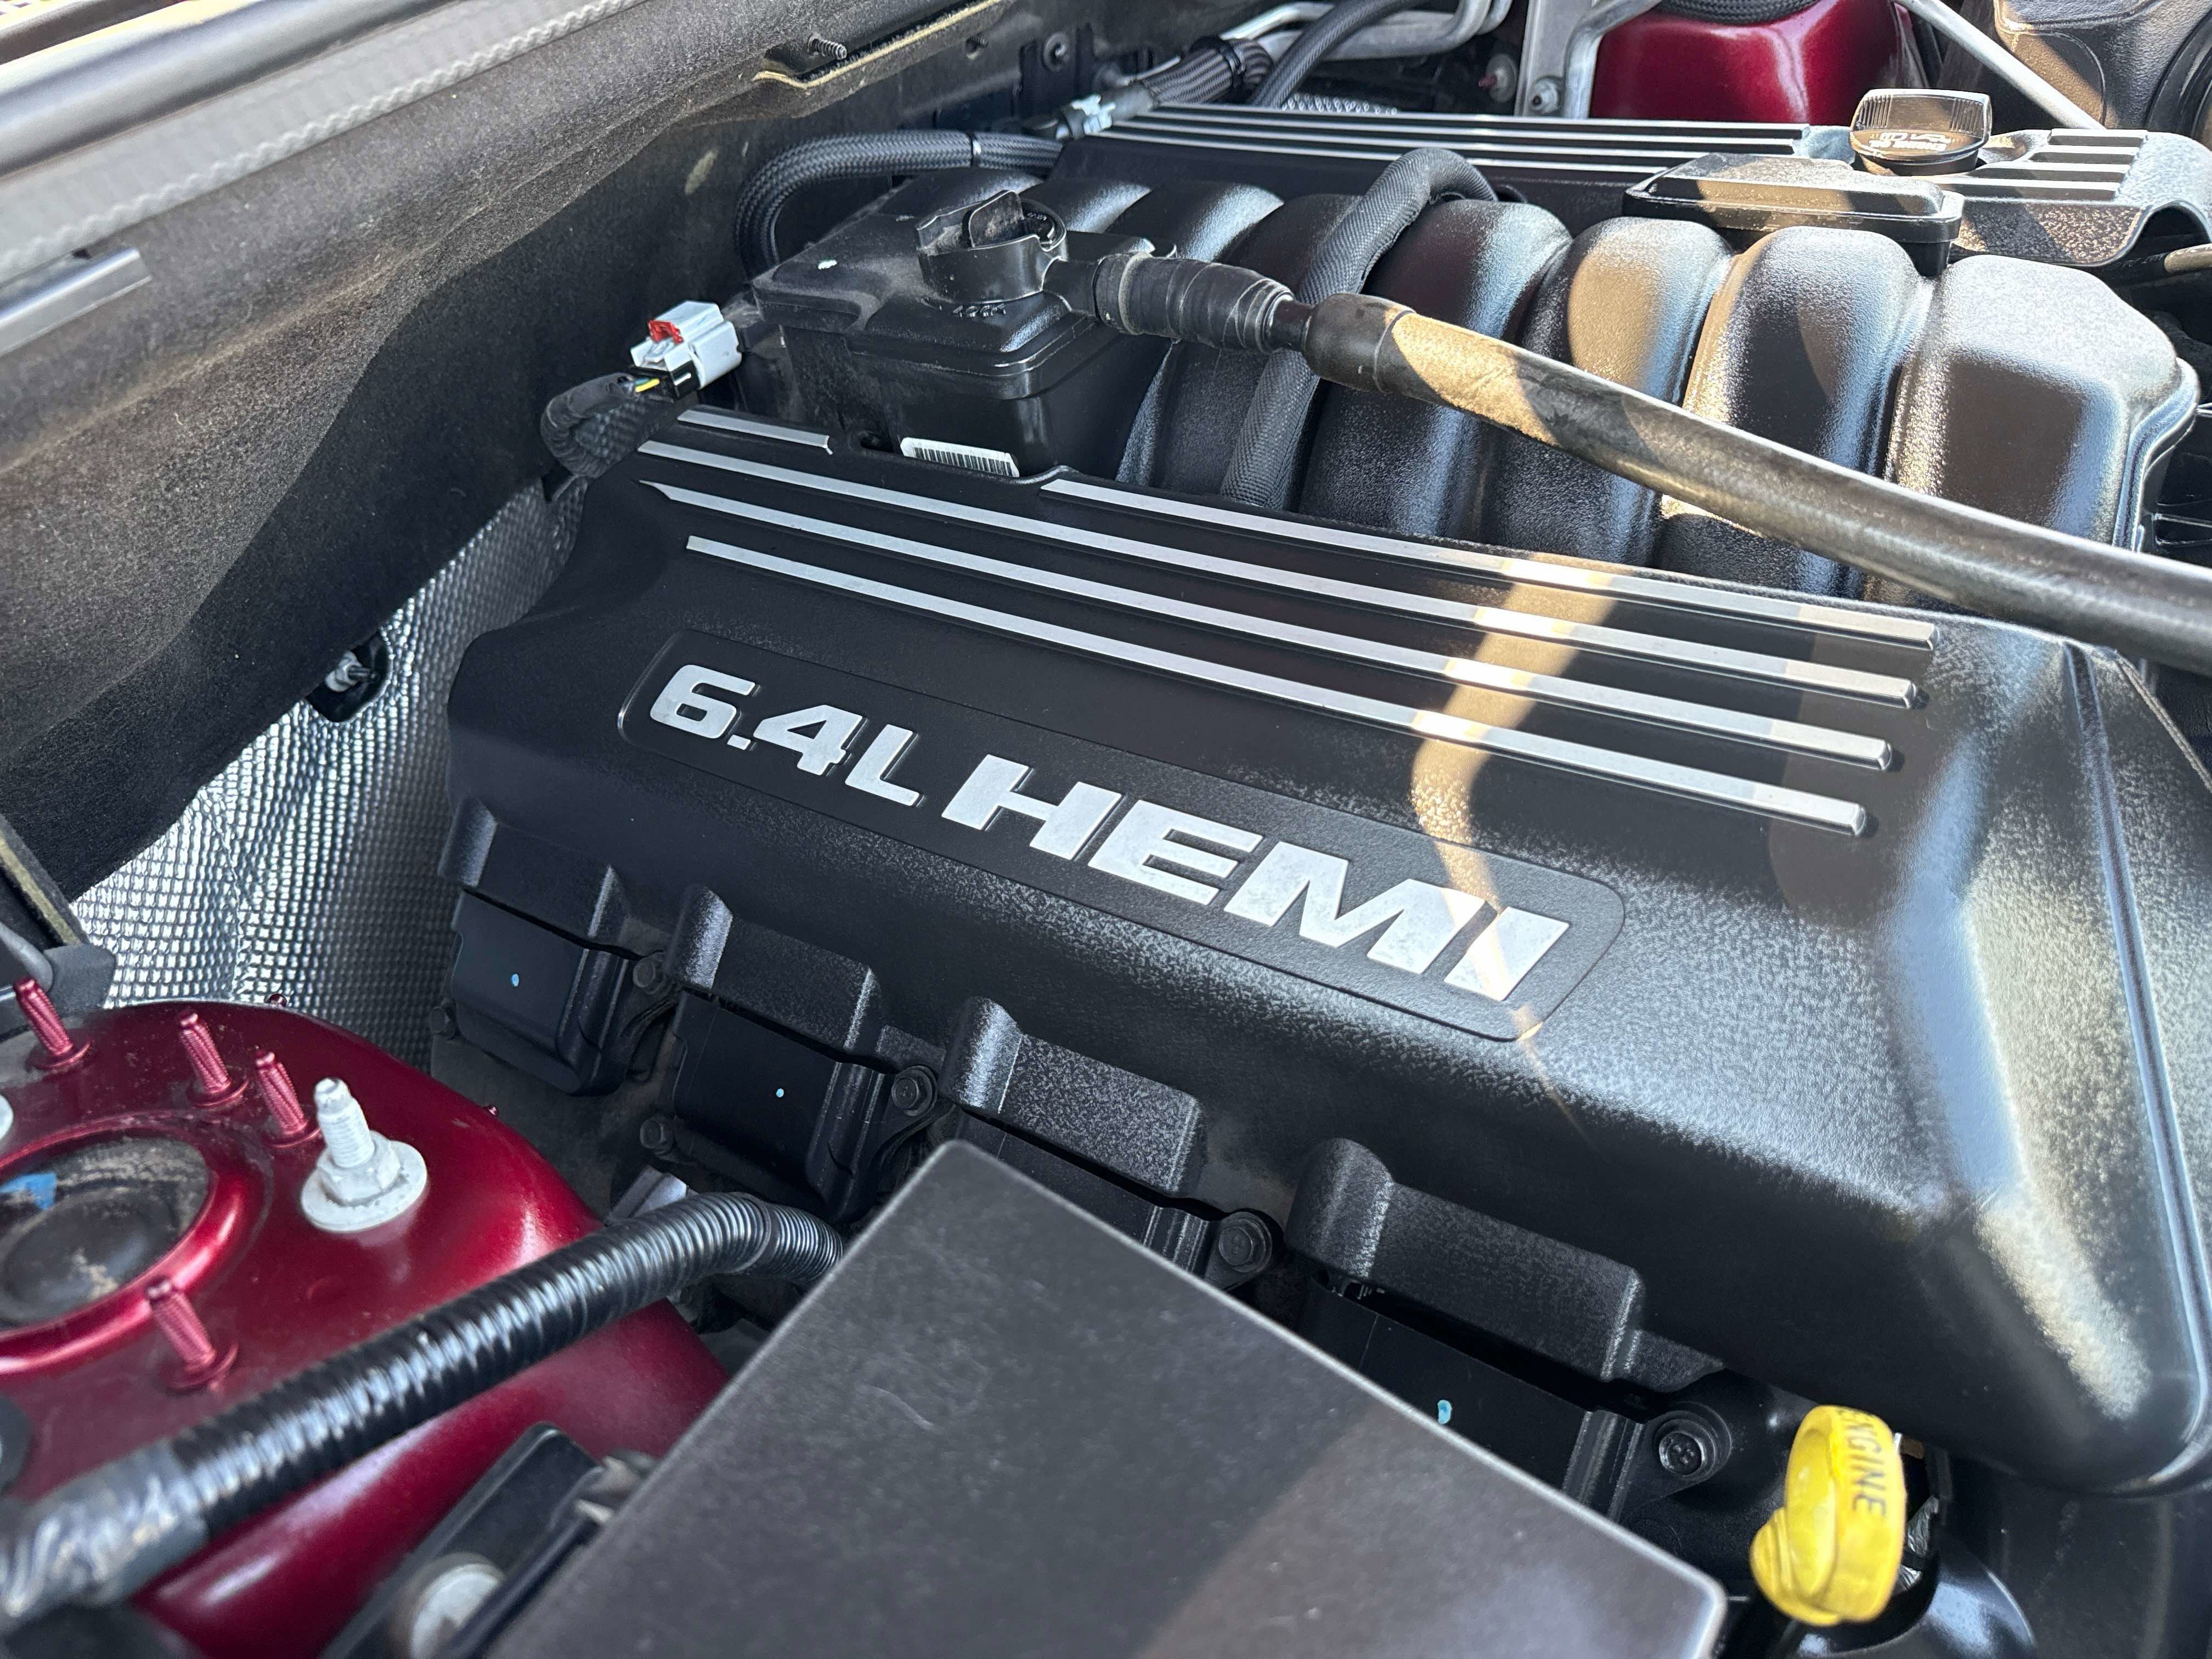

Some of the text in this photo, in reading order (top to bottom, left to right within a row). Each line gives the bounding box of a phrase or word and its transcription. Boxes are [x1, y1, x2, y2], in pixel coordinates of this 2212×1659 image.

[650, 664, 1570, 1002] 6.4L HEMI
[1837, 1406, 1887, 1516] ENGINE
